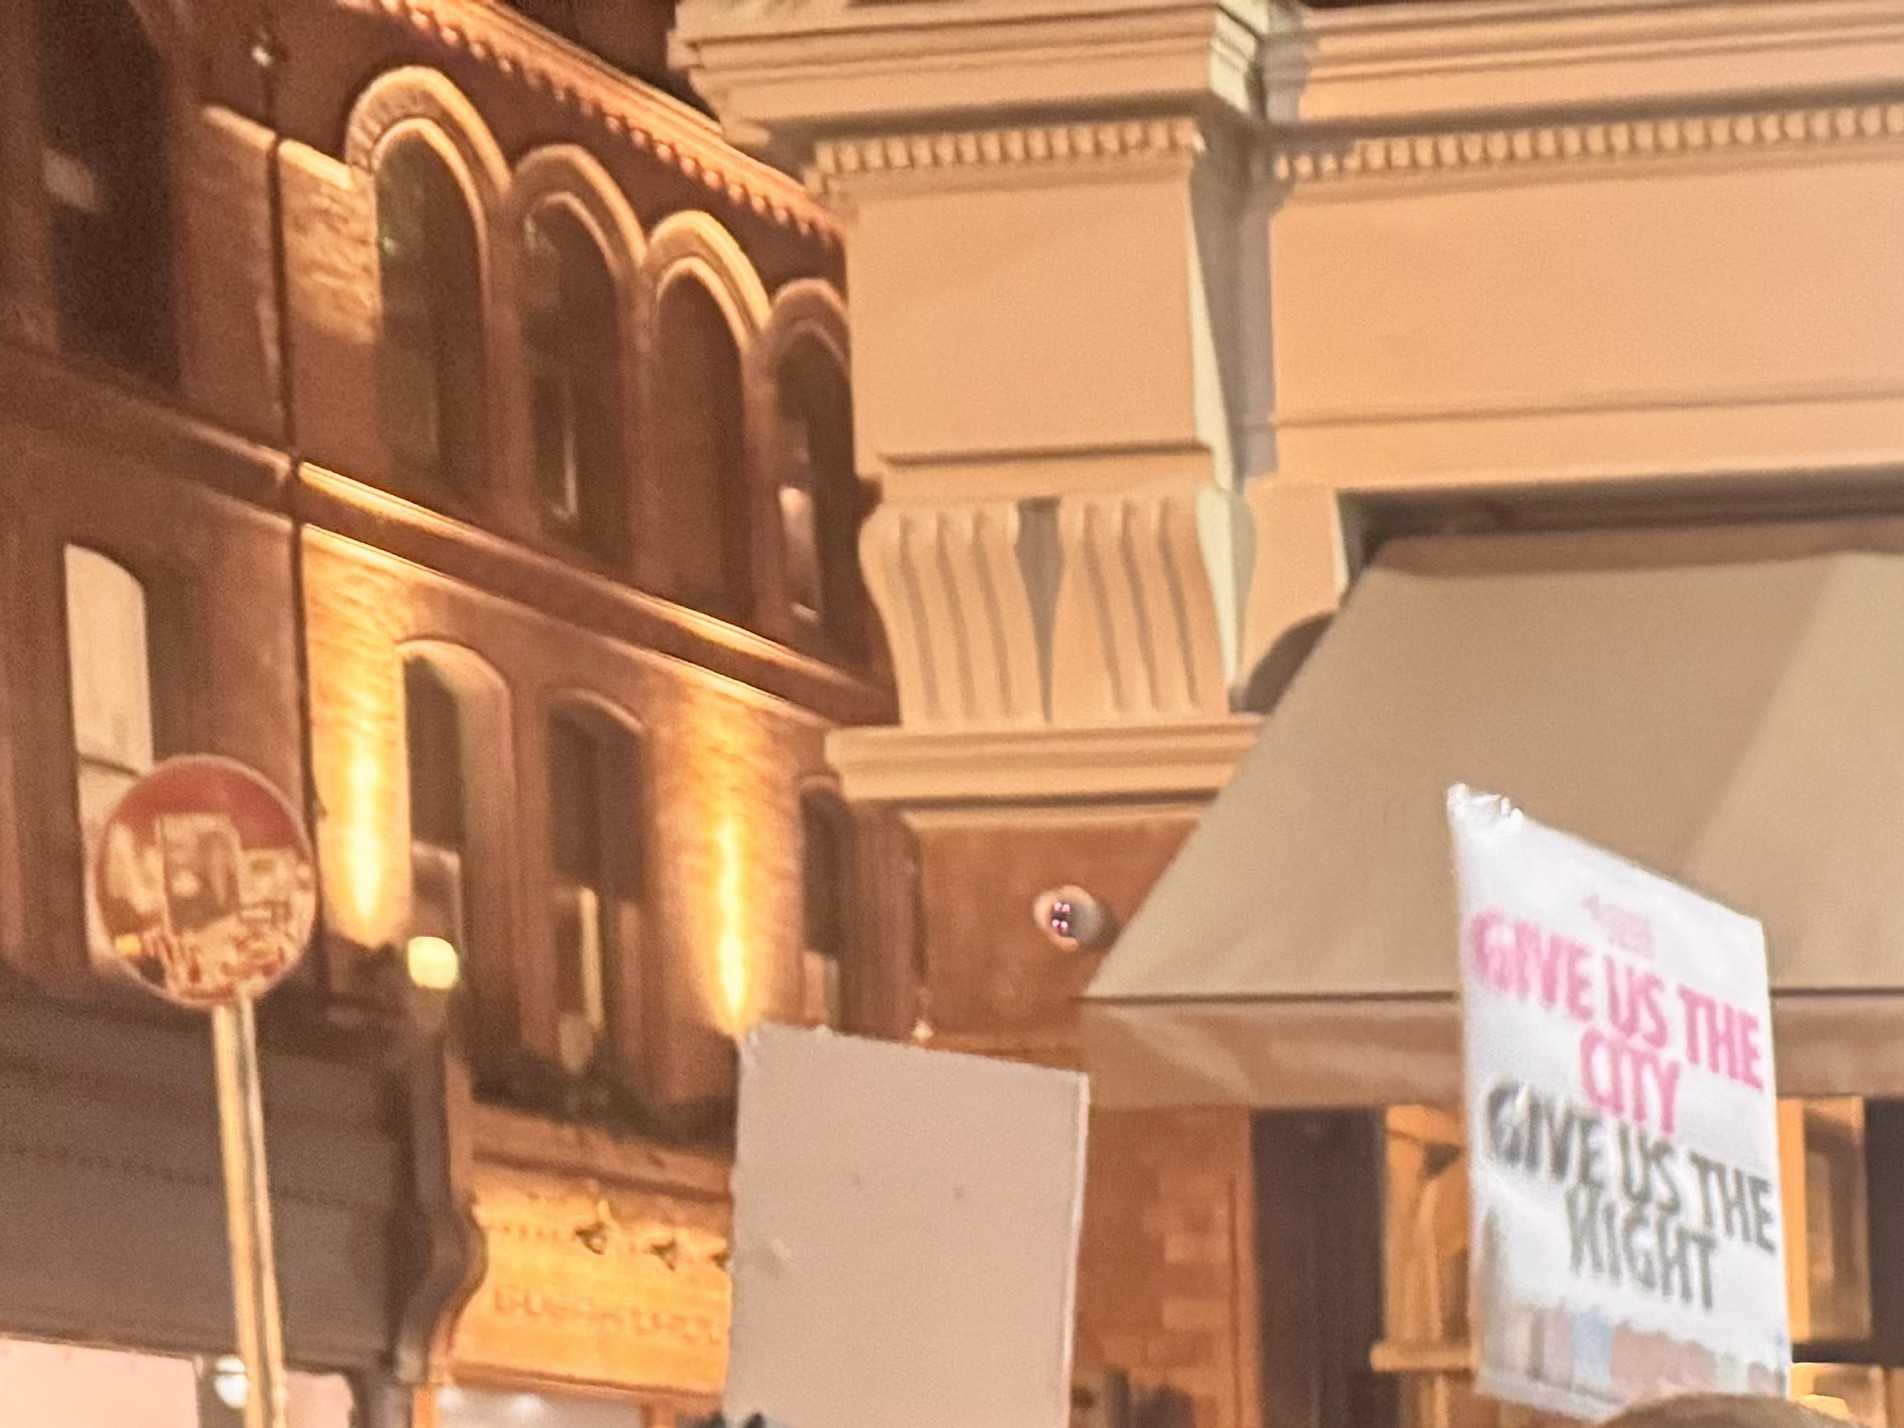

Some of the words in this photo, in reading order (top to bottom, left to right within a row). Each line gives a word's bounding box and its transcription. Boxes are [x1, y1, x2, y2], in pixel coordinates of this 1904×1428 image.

[1472, 909, 1593, 1023] GIVE
[1603, 953, 1668, 1049] US
[1676, 983, 1763, 1093] THE
[1579, 1026, 1681, 1134] CITY
[1487, 1079, 1602, 1188] GIVE
[1617, 1118, 1680, 1214] US
[1687, 1149, 1774, 1254] THE
